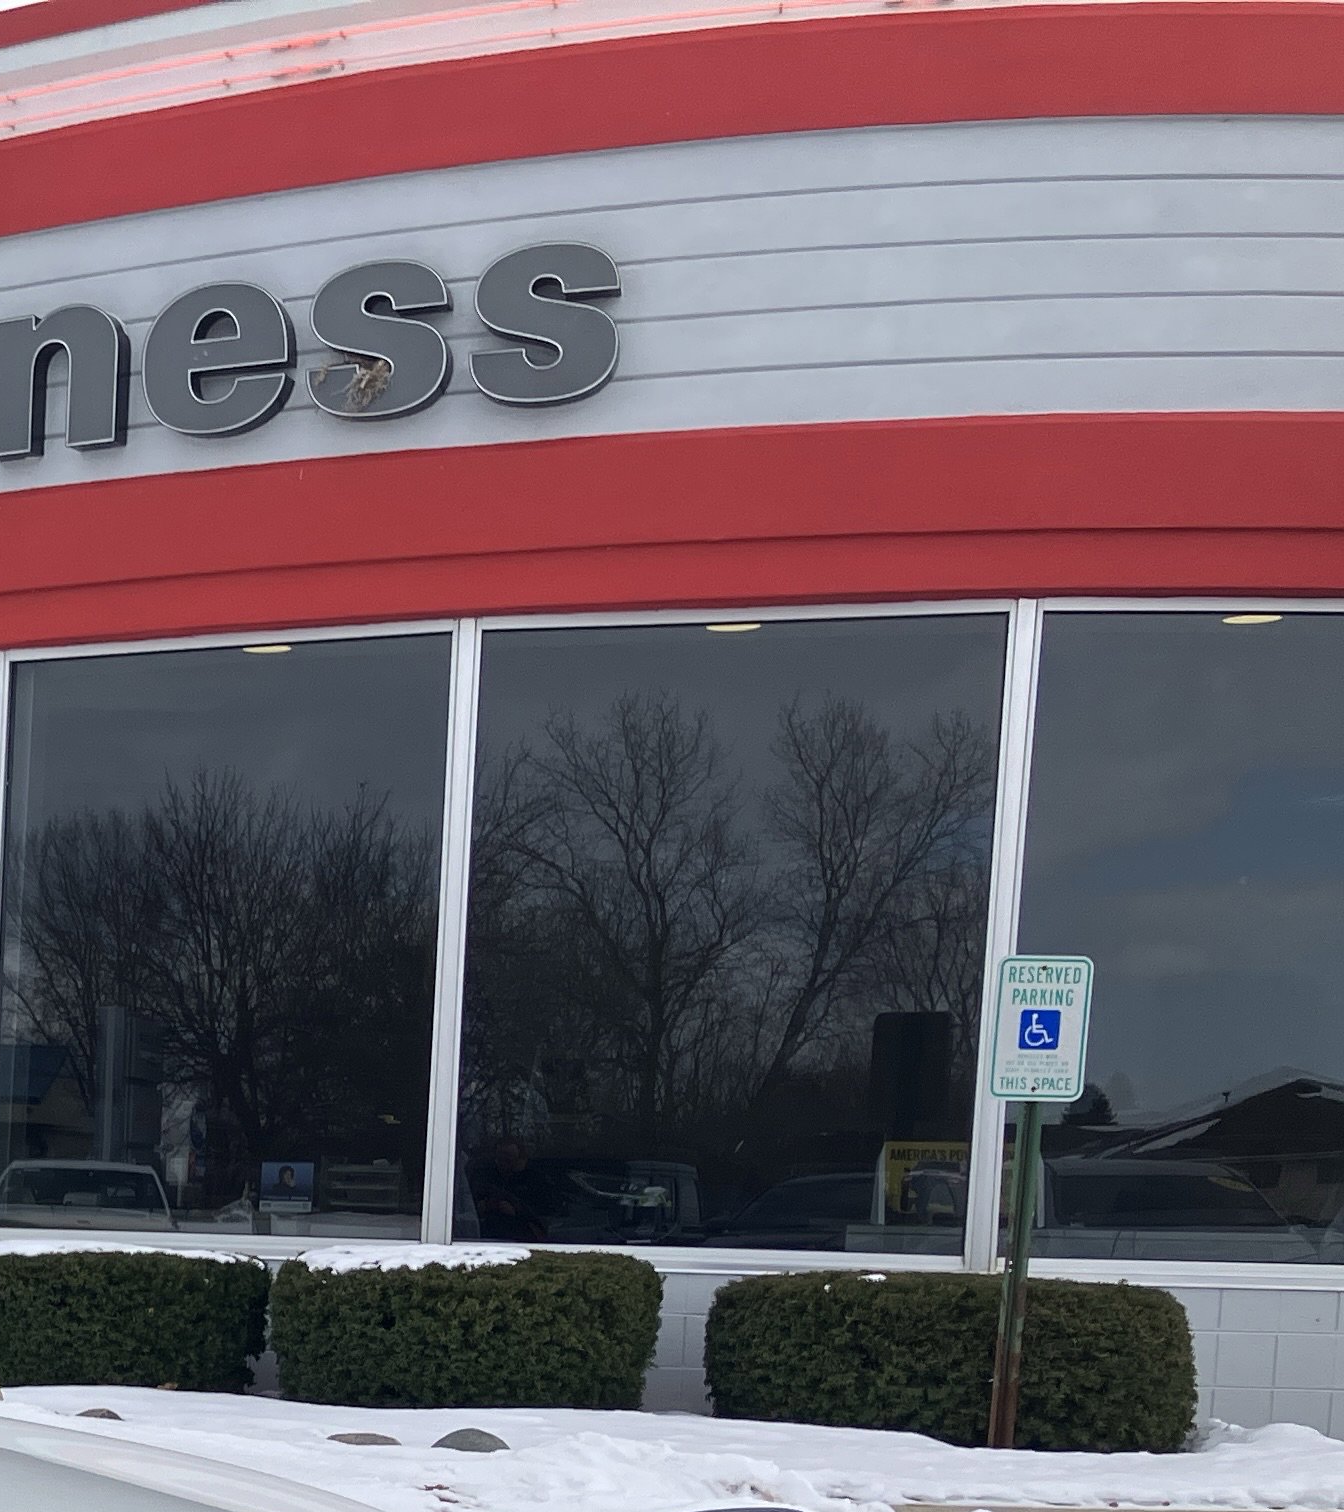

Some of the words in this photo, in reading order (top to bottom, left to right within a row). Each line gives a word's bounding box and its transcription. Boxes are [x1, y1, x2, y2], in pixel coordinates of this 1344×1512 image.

[1008, 966, 1082, 984] RESERVED
[1011, 988, 1074, 1006] PARKING
[999, 1077, 1027, 1090] THIS
[1033, 1077, 1072, 1091] SPACE
